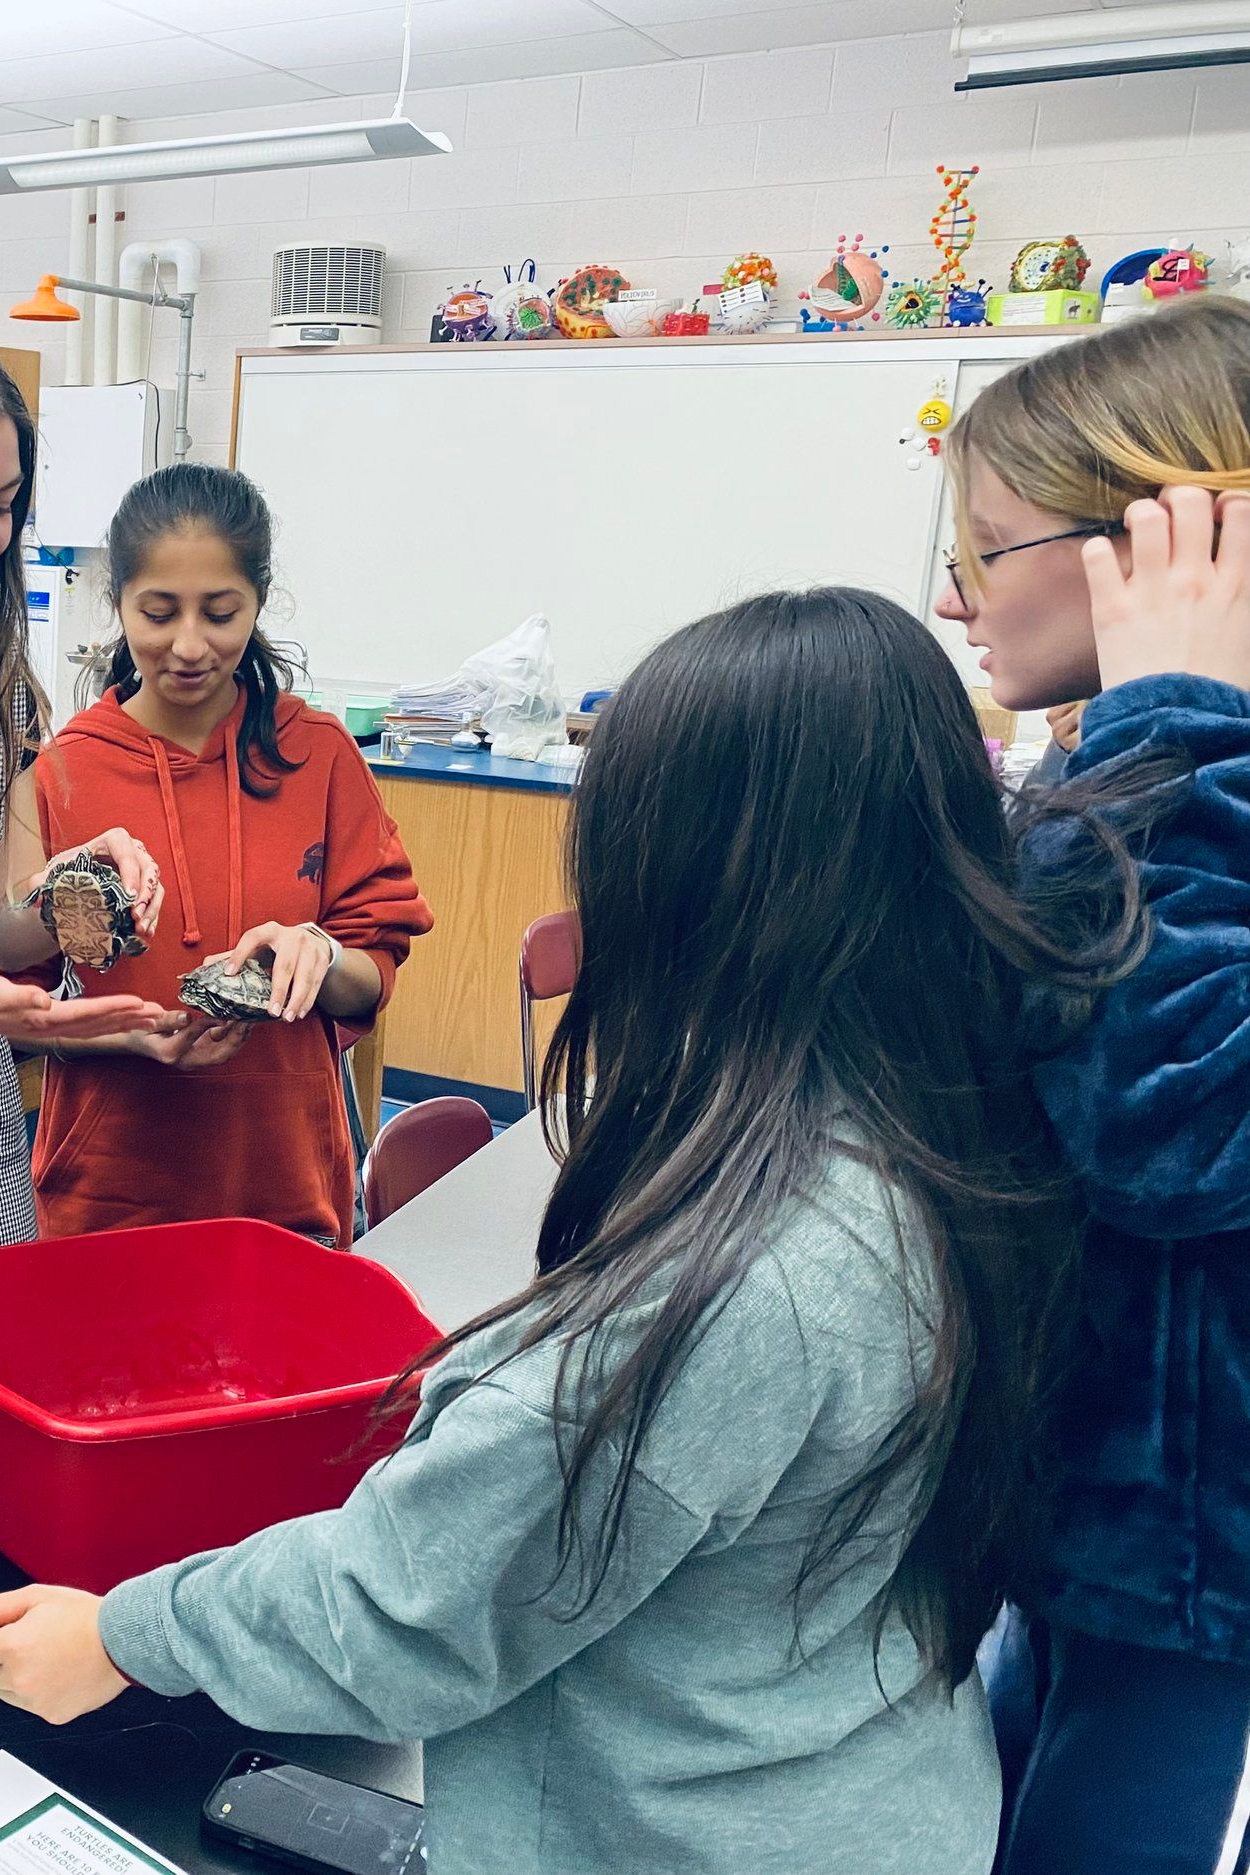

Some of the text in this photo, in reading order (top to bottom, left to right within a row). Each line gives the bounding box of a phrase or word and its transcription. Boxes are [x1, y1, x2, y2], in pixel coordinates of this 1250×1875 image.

[26, 1834, 47, 1850] YOU
[36, 1832, 61, 1850] HERE
[60, 1850, 80, 1865] ARE
[81, 1863, 92, 1873] 10
[61, 1827, 127, 1875] ENDANGERED!
[74, 1825, 133, 1868] TURTLES ARE
